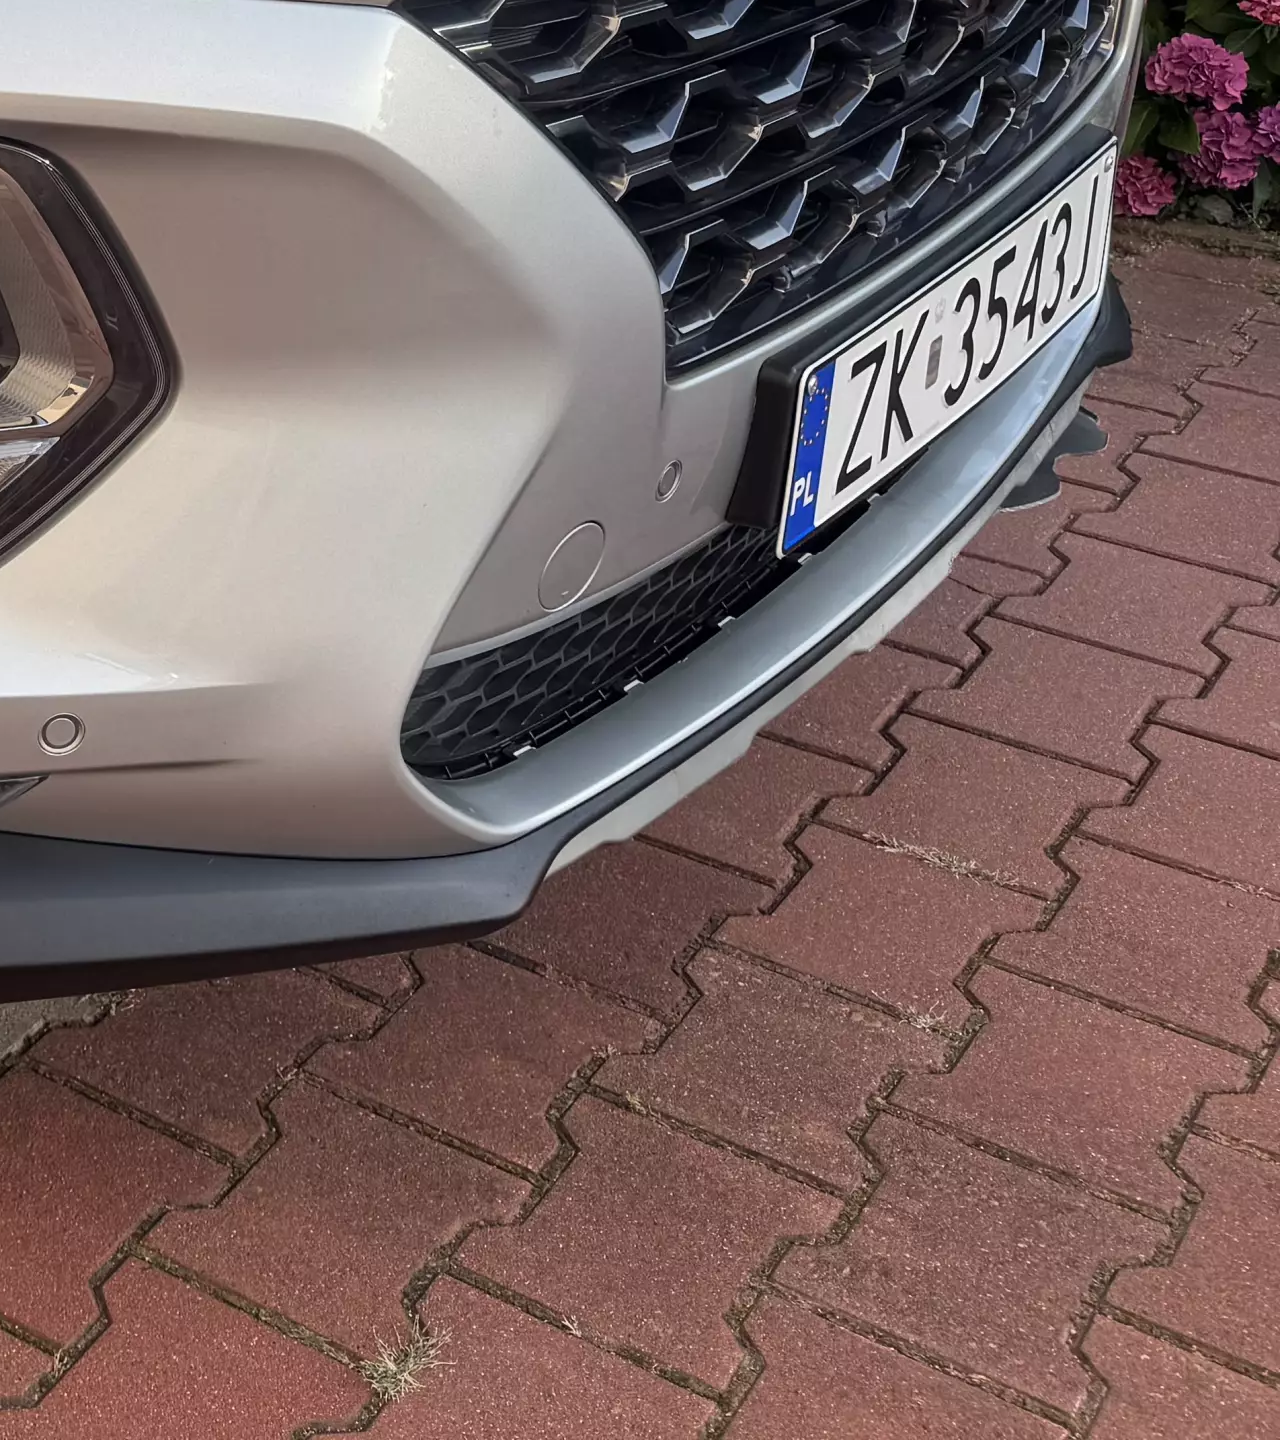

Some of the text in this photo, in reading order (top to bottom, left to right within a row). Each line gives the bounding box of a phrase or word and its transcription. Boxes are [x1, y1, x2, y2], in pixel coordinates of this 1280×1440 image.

[834, 174, 1099, 497] ZK 3543J
[789, 476, 815, 517] PL
